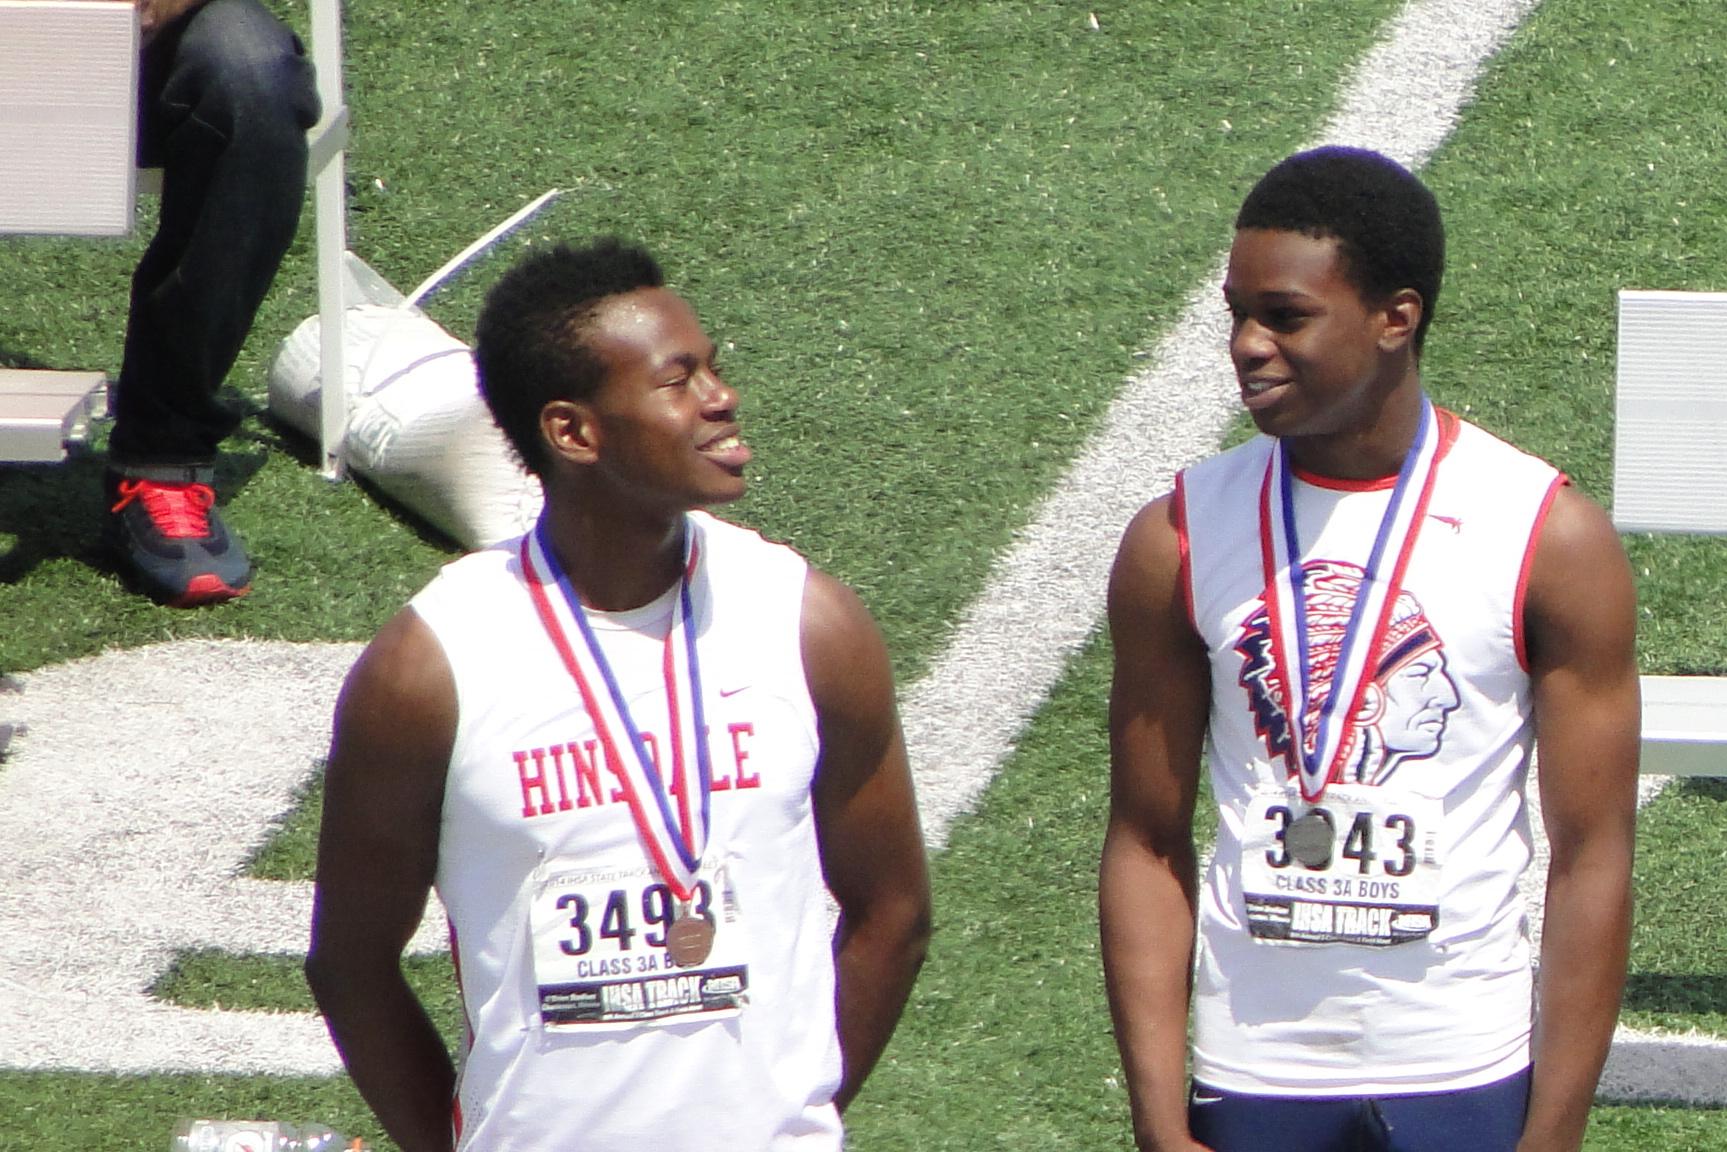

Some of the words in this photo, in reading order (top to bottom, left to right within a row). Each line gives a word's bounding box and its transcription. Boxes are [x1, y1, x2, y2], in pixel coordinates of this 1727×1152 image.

[1275, 875, 1327, 895] CLASS
[1333, 879, 1353, 897] 3A
[1358, 881, 1400, 899] BOYS
[1292, 902, 1333, 933] IHSA
[1334, 905, 1393, 936] TRACK
[577, 955, 632, 978] CLASS
[637, 953, 659, 974] 3A
[645, 976, 704, 1009] TRACK
